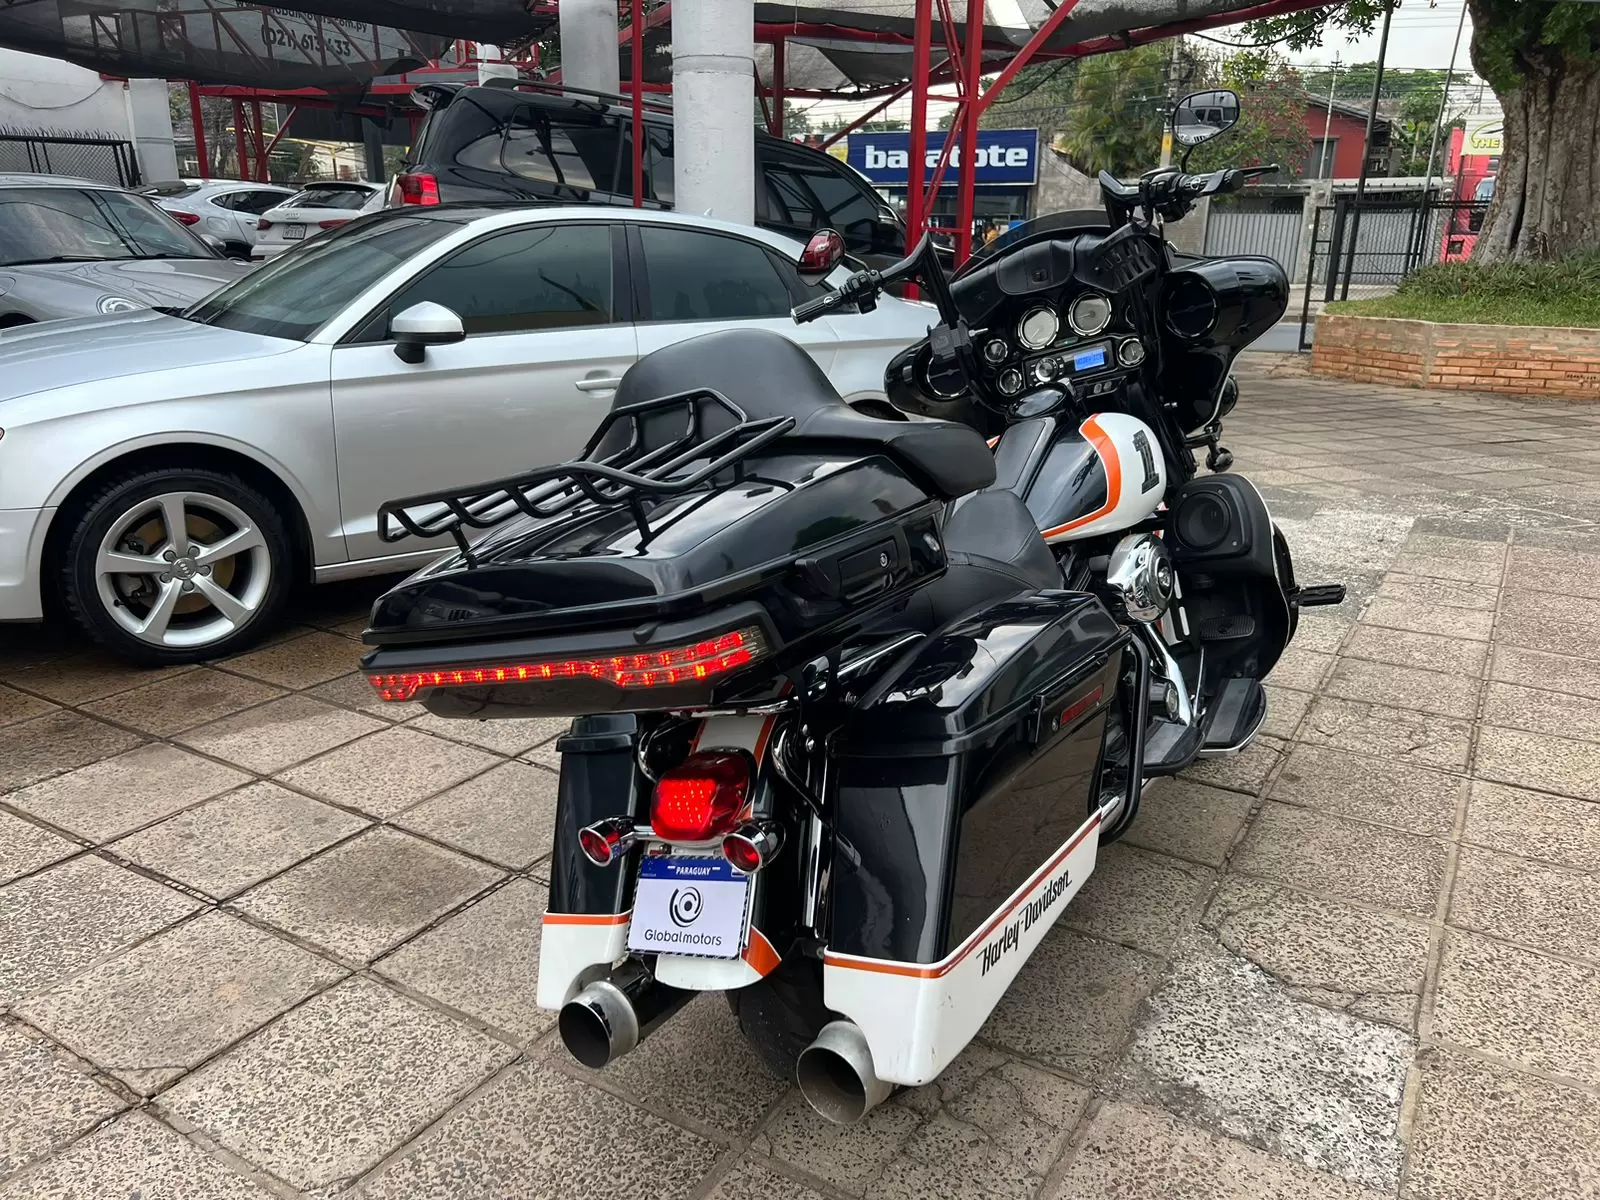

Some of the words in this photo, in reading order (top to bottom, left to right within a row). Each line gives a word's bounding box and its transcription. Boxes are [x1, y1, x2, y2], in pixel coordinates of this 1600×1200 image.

[1472, 138, 1500, 148] THE
[865, 145, 1029, 169] baatote
[675, 866, 711, 876] PARAGUAY
[976, 869, 1073, 977] Harley-Davidson
[644, 928, 722, 946] Globalmotors
